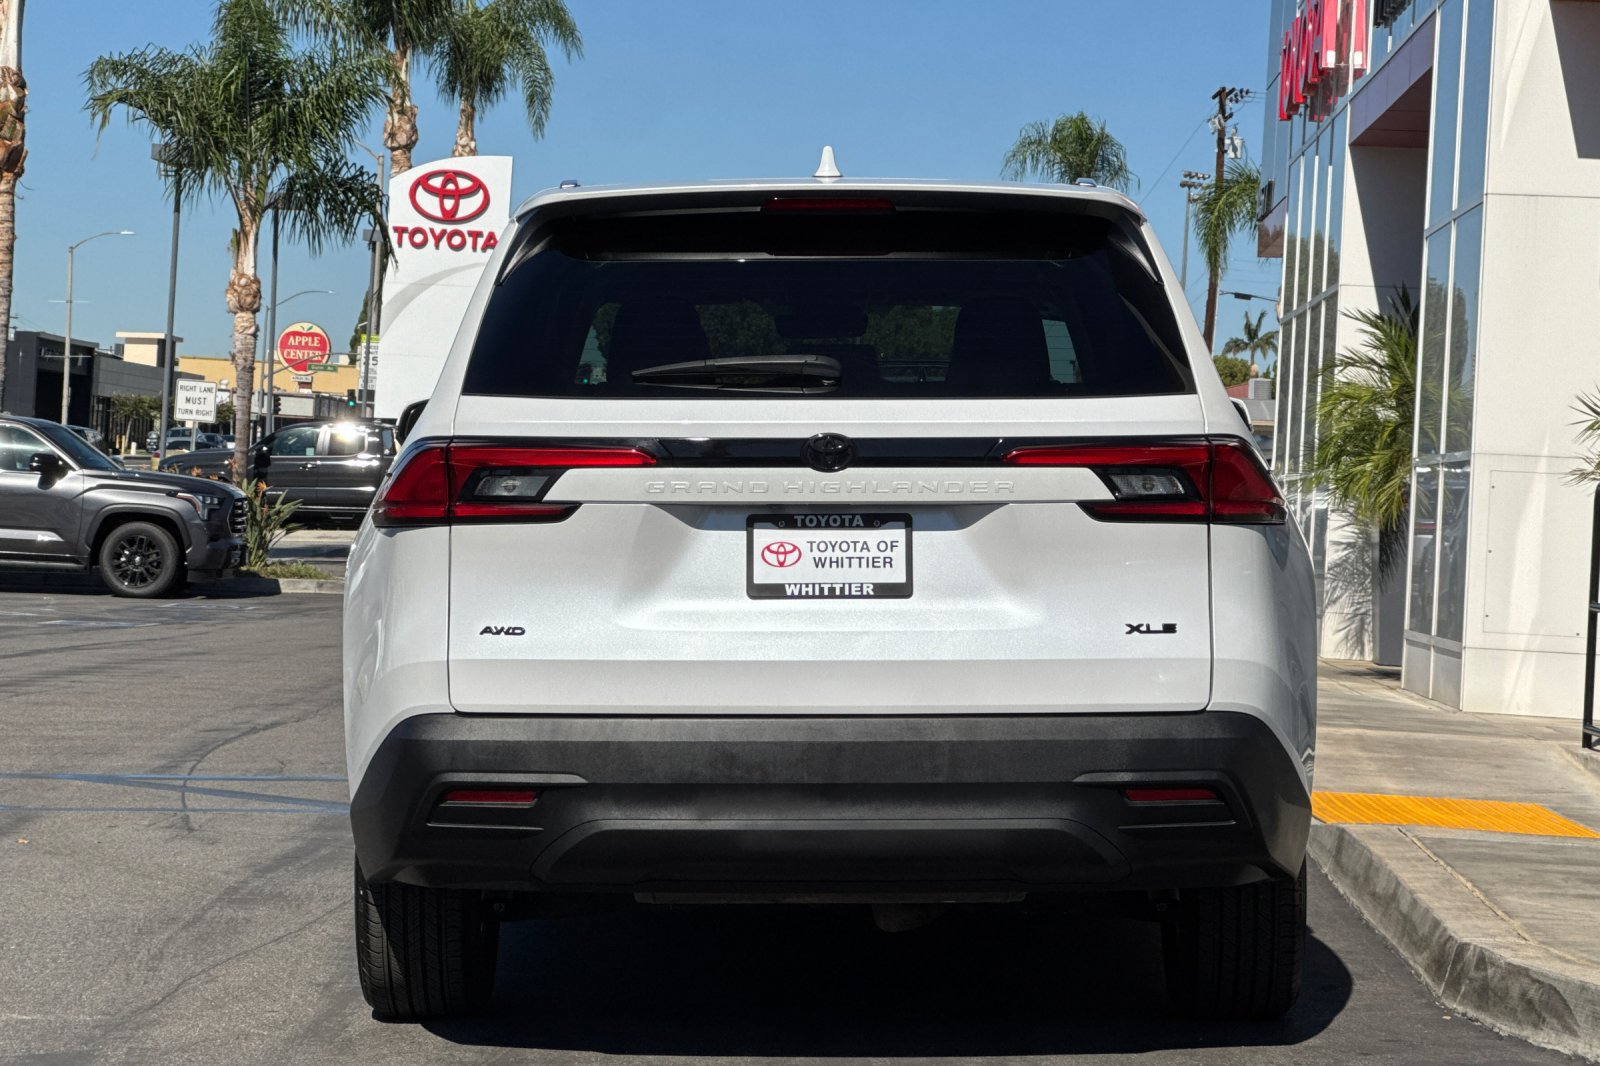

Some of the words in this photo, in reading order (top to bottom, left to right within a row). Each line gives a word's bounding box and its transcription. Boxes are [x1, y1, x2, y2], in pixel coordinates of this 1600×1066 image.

[392, 226, 498, 253] TOYOTA
[288, 335, 321, 347] APPLE
[283, 348, 322, 361] CENTER
[180, 384, 197, 393] RIGHT
[199, 386, 214, 394] LANE
[185, 396, 207, 406] MUST
[178, 408, 194, 416] TURN
[195, 409, 213, 417] RIGHT
[646, 480, 769, 494] GRAND
[783, 480, 1015, 494] HIGHLANDER
[794, 515, 864, 527] TOYOTA
[807, 540, 870, 553] TOYOTA
[877, 540, 899, 553] OF
[813, 556, 894, 569] WHITTIER
[785, 583, 874, 596] WHITTIER
[479, 625, 526, 636] AWD
[1125, 623, 1177, 635] XLE
